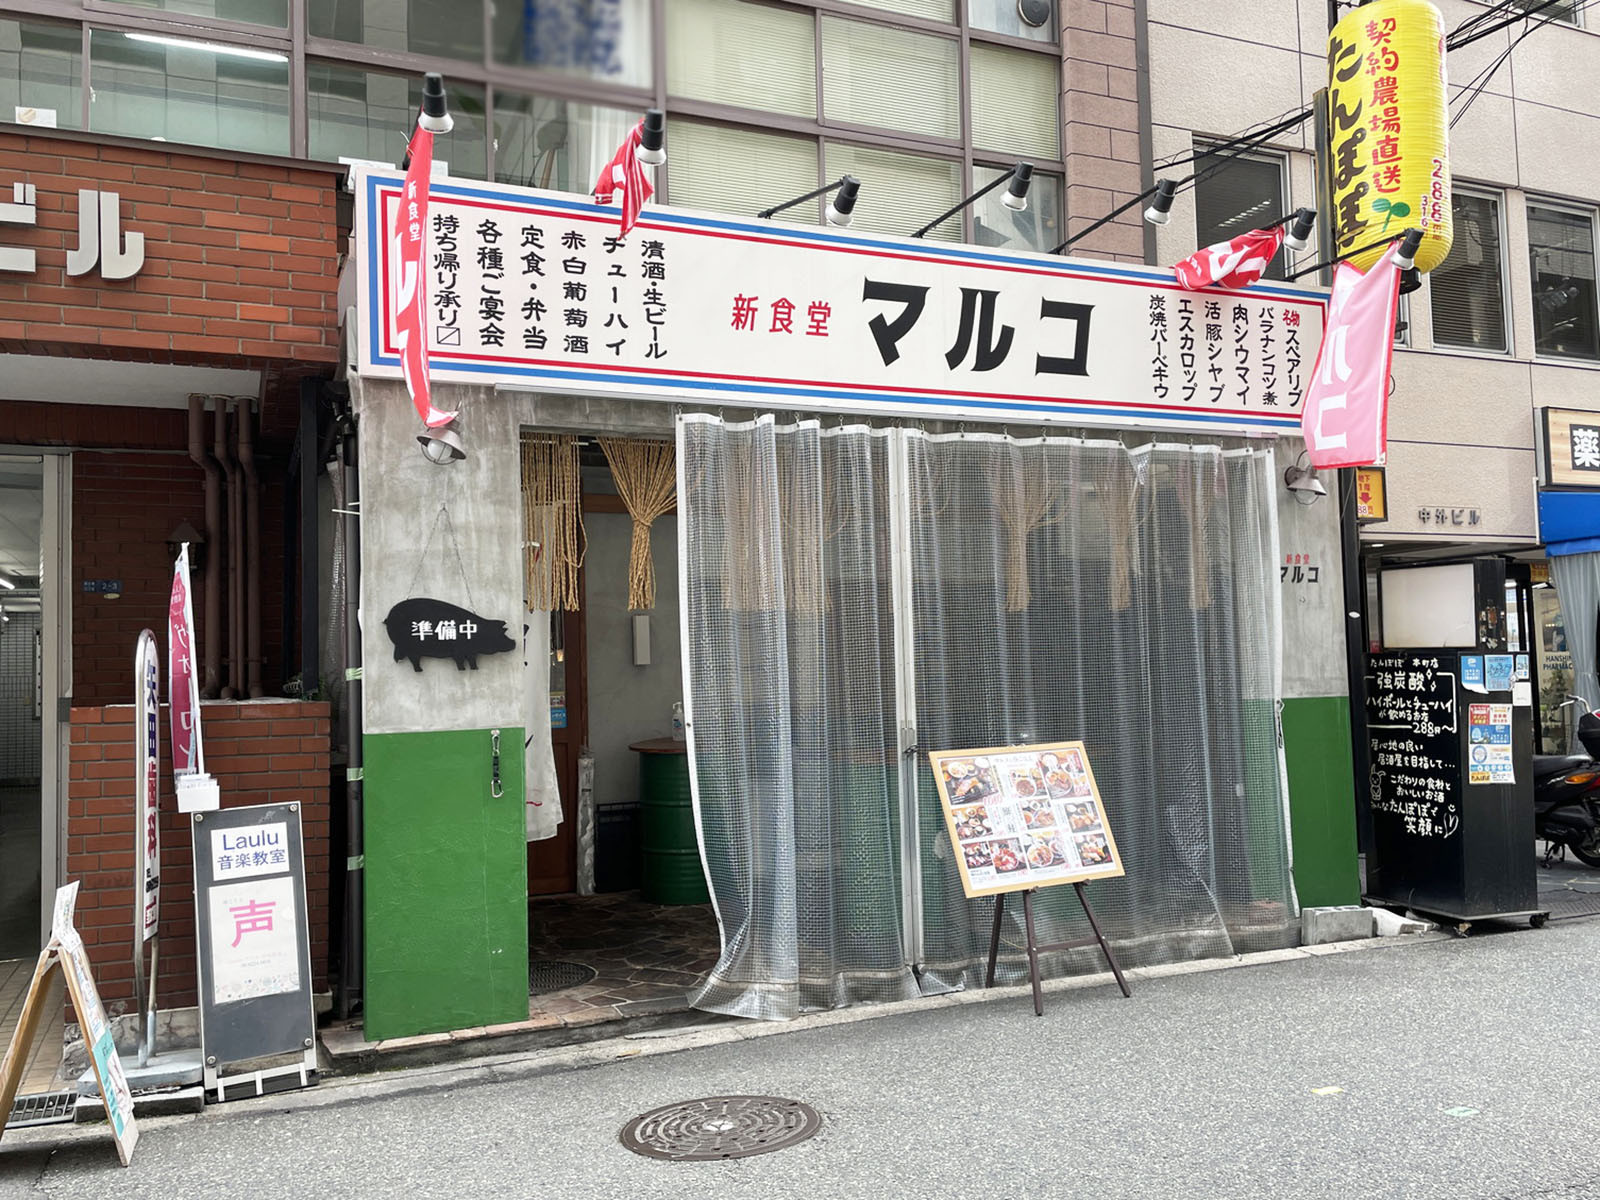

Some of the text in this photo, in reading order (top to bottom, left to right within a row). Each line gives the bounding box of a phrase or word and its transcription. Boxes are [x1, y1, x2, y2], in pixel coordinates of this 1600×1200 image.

[1364, 17, 1402, 193] 契約農場直送
[407, 180, 421, 242] 新食堂
[476, 219, 505, 347] 各種ご宴会
[520, 224, 548, 350] 定食・弁当
[561, 230, 589, 353] 赤白葡萄酒
[603, 236, 629, 356] チューハイ
[641, 240, 668, 359] 清酒・生ビール
[730, 276, 1096, 377] 新食堂 マルコ
[1149, 294, 1169, 399] 炭焼バーベキウ
[1178, 299, 1198, 401] エスカロップ
[1233, 303, 1250, 405] 肉シウマイ
[1258, 306, 1278, 406] バラナンコツ煮
[1573, 428, 1600, 467] 薬
[411, 620, 478, 641] 準備中
[1377, 670, 1426, 691] 強炭酸
[1412, 658, 1439, 668] 本町店
[1366, 693, 1453, 713] ハイボールとチューハイ
[1379, 709, 1429, 722] が飲めるお店
[1390, 774, 1451, 790] こだわりの食材と
[1396, 785, 1445, 803] おいしいお酒
[223, 830, 279, 850] Laulu
[1404, 815, 1444, 836] 笑顔に
[217, 849, 286, 871] 音楽教室
[229, 899, 276, 948] 声
